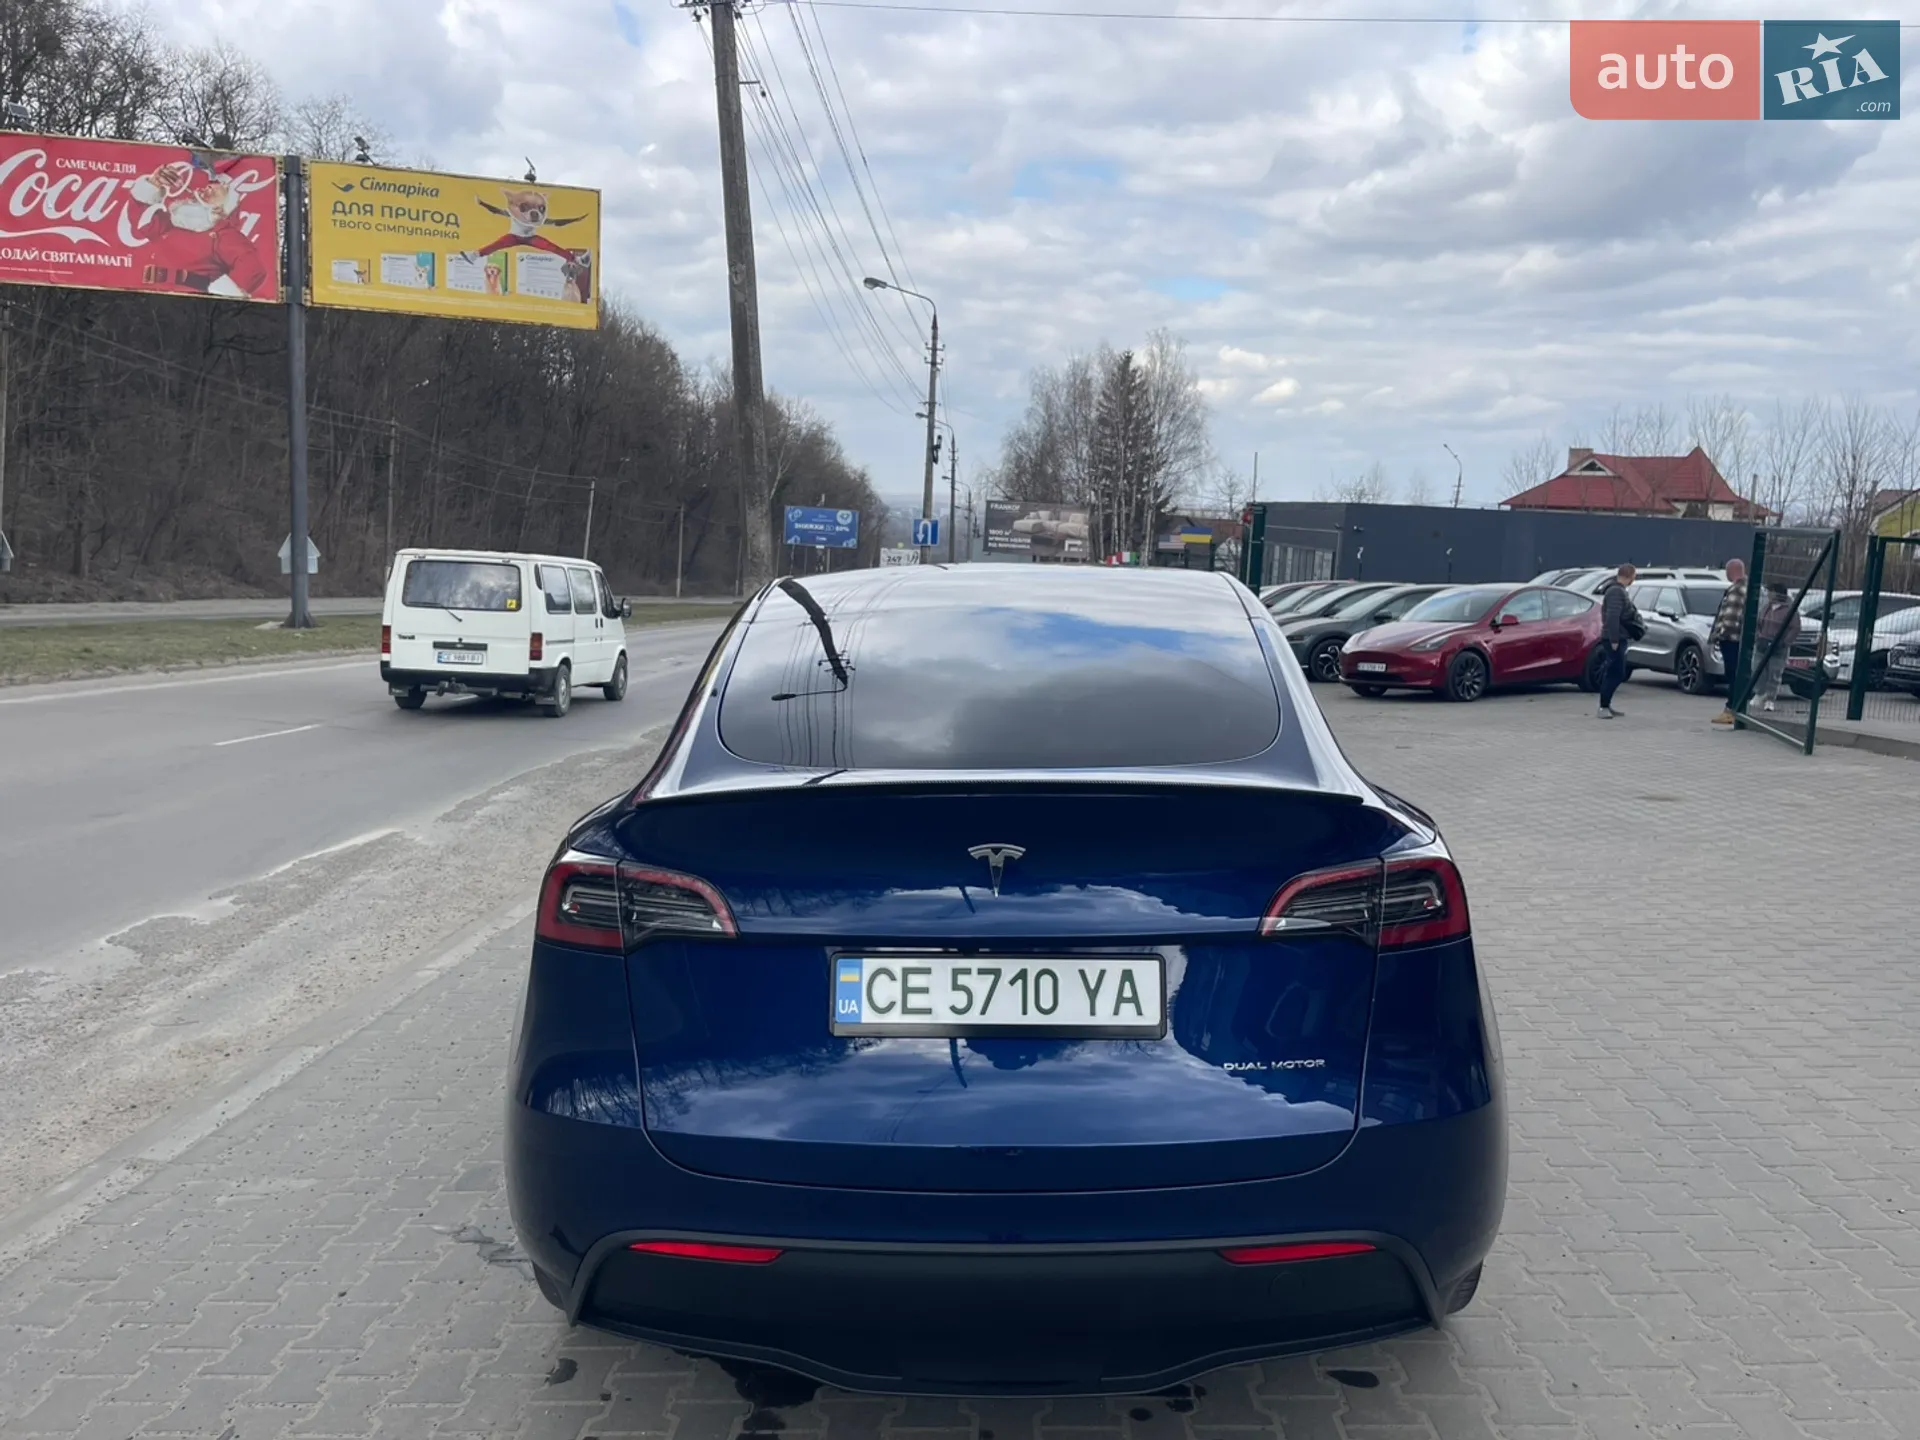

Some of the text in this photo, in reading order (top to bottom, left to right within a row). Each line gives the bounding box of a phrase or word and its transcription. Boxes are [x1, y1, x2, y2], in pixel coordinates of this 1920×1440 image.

[56, 158, 136, 174] САМЕ ЧАС ДЛЯ
[359, 176, 440, 198] Сімпаріка
[331, 200, 460, 228] ДЛЯ ПРИГОД
[331, 218, 460, 240] ТВОГО СІМПУПАРІКА
[0, 247, 133, 268] ОДАЙ СВЯТАМ МАГІЇ
[865, 966, 1144, 1016] CE 5710 YA
[838, 999, 859, 1015] UA
[1223, 1059, 1326, 1071] DUAL MOTOR
